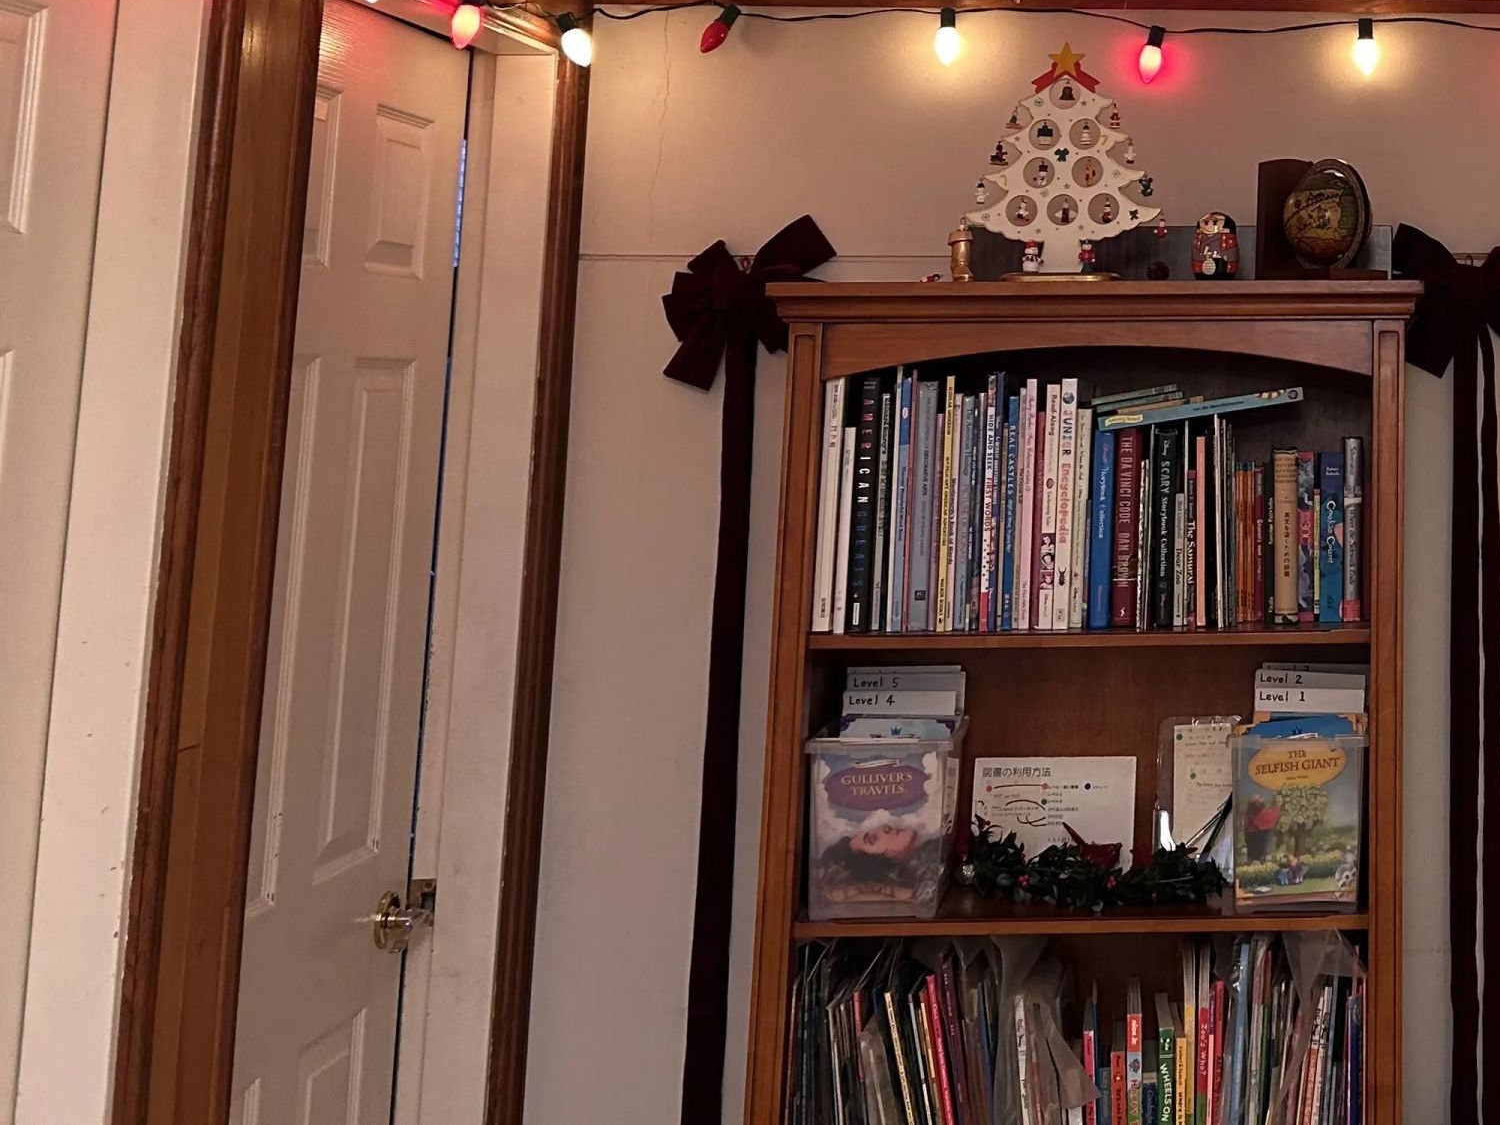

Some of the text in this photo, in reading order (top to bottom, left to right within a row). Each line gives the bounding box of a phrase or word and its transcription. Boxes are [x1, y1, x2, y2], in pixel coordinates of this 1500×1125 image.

[1049, 394, 1058, 436] Read-Along
[857, 398, 875, 505] AMERICAN
[1009, 424, 1017, 448] REAL
[1007, 452, 1016, 496] CASTLES
[1059, 409, 1074, 544] JUNIOR Encyclopedia
[1099, 466, 1110, 502] Storybook
[1118, 436, 1134, 524] THE DA VINCI CODE
[1160, 460, 1171, 494] SCARY
[983, 502, 992, 532] WORDS
[1097, 504, 1107, 539] Collection
[1159, 496, 1169, 536] Storybook
[1187, 520, 1196, 539] The
[1326, 500, 1337, 564] Cookie Count
[1118, 531, 1130, 552] DAN
[1159, 537, 1168, 578] Collection
[1175, 547, 1183, 586] Dear Zoo
[1187, 540, 1196, 584] Samurai
[853, 676, 899, 688] Level 5
[1259, 672, 1303, 684] Level 2
[848, 693, 895, 706] Level 4
[1259, 690, 1306, 702] Level 1
[1255, 757, 1341, 775] SELFISH GIANT
[1287, 749, 1306, 759] THE
[840, 772, 913, 785] GULLIVER'S
[850, 784, 905, 796] TRAVELS
[982, 767, 1051, 778] 図書の利用方法
[1199, 1023, 1208, 1076] Zoo's Who?
[1130, 1079, 1139, 1116] HAPPY
[1160, 1063, 1172, 1122] WHEELS ON
